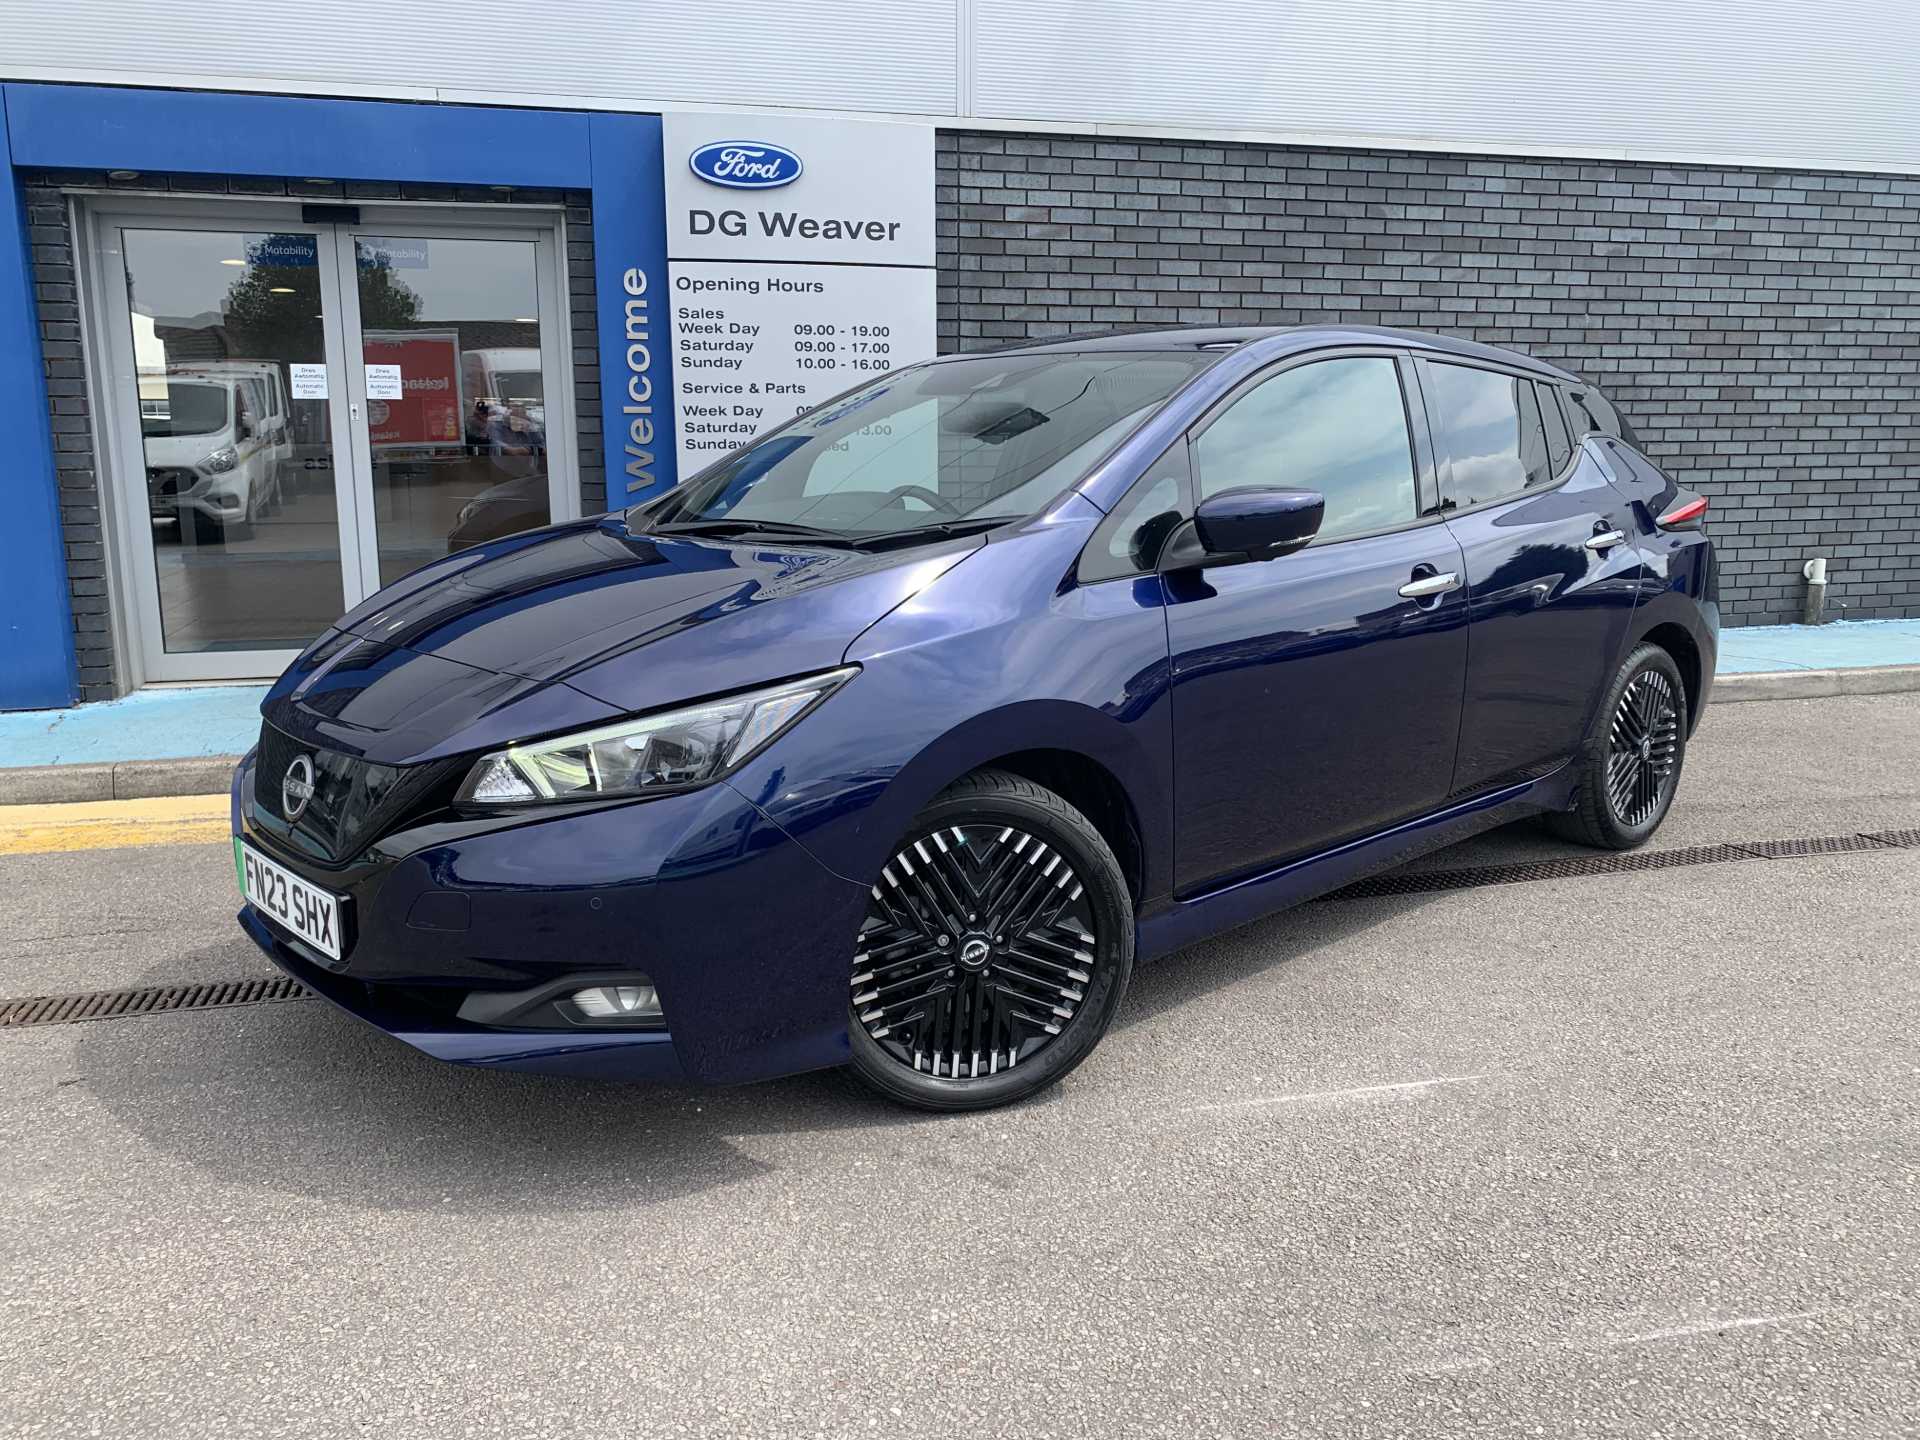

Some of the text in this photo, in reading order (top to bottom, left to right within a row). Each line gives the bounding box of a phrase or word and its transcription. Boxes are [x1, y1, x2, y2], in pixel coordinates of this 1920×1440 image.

[713, 147, 782, 179] Ford
[688, 209, 901, 242] DG Weaver
[264, 245, 315, 258] Motability
[675, 276, 824, 295] Opening Hours
[678, 307, 725, 320] Sales
[678, 322, 724, 335] Week
[729, 323, 760, 337] Day
[793, 324, 835, 336] 09.00
[851, 325, 890, 337] 19.00
[680, 339, 754, 354] Saturday
[794, 341, 836, 353] 09.00
[851, 342, 890, 354] 17.00
[681, 356, 743, 371] Sunday
[795, 358, 836, 370] 10.00
[851, 359, 890, 371] 16.00
[623, 267, 656, 493] Welcome
[682, 382, 807, 395] Service & Parts
[682, 404, 764, 420] Week Day
[684, 421, 757, 436] Saturday
[245, 851, 334, 949] FN23 SHX
